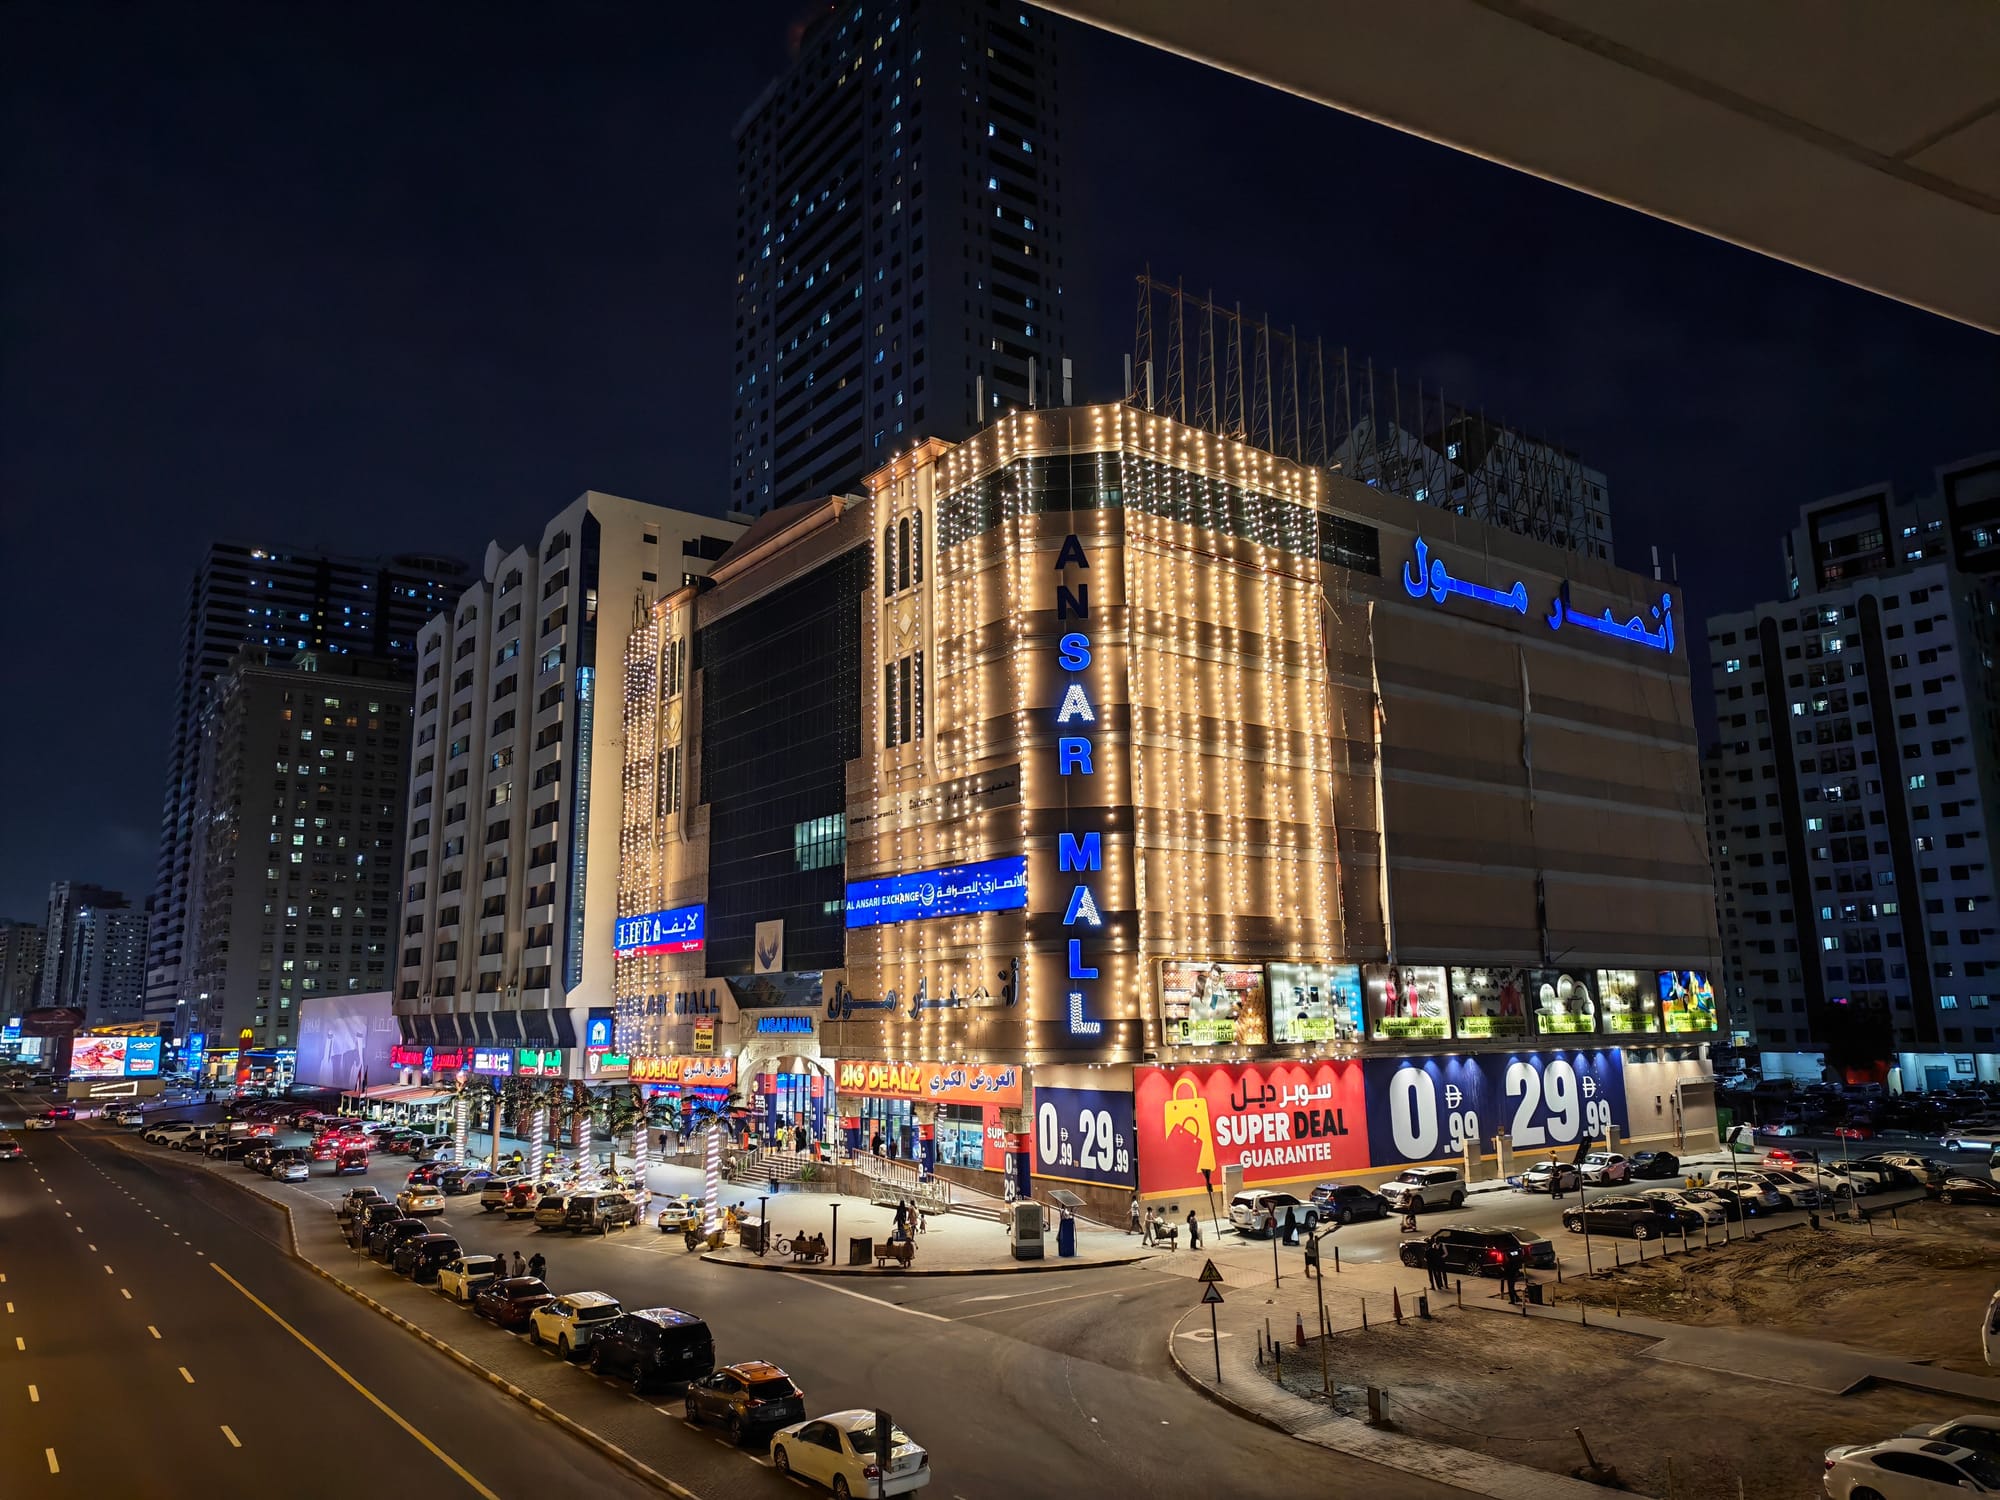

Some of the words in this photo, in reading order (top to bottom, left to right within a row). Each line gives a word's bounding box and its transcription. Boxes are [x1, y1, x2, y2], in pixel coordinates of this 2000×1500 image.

[1403, 536, 1529, 615] مول
[1546, 579, 1675, 654] أنصار
[1055, 534, 1095, 776] ANSAR
[846, 901, 855, 911] AL
[855, 896, 880, 909] ANSARI
[881, 890, 920, 906] EXCHANGE
[618, 919, 652, 947] LIFE
[662, 912, 699, 938] لايف
[1059, 832, 1102, 1034] MALL
[675, 988, 720, 1015] MALL
[827, 980, 897, 1021] مول
[757, 1017, 788, 1033] ANSAR
[788, 1016, 813, 1033] MALL
[1182, 1021, 1189, 1036] G
[1375, 1019, 1381, 1032] 2
[1460, 1018, 1465, 1031] 3
[631, 1059, 647, 1077] BIG
[648, 1058, 680, 1079] DEALZ
[840, 1064, 865, 1088] BIG
[868, 1064, 922, 1091] DEALZ
[969, 1068, 1016, 1093] العروض
[1231, 1078, 1277, 1112] ديل
[1279, 1083, 1332, 1108] سوبر
[1505, 1060, 1581, 1147] 29
[1080, 1109, 1114, 1172] 29
[1215, 1112, 1291, 1146] SUPER
[1293, 1108, 1349, 1139] DEAL
[1240, 1142, 1332, 1168] GUARANTEE
